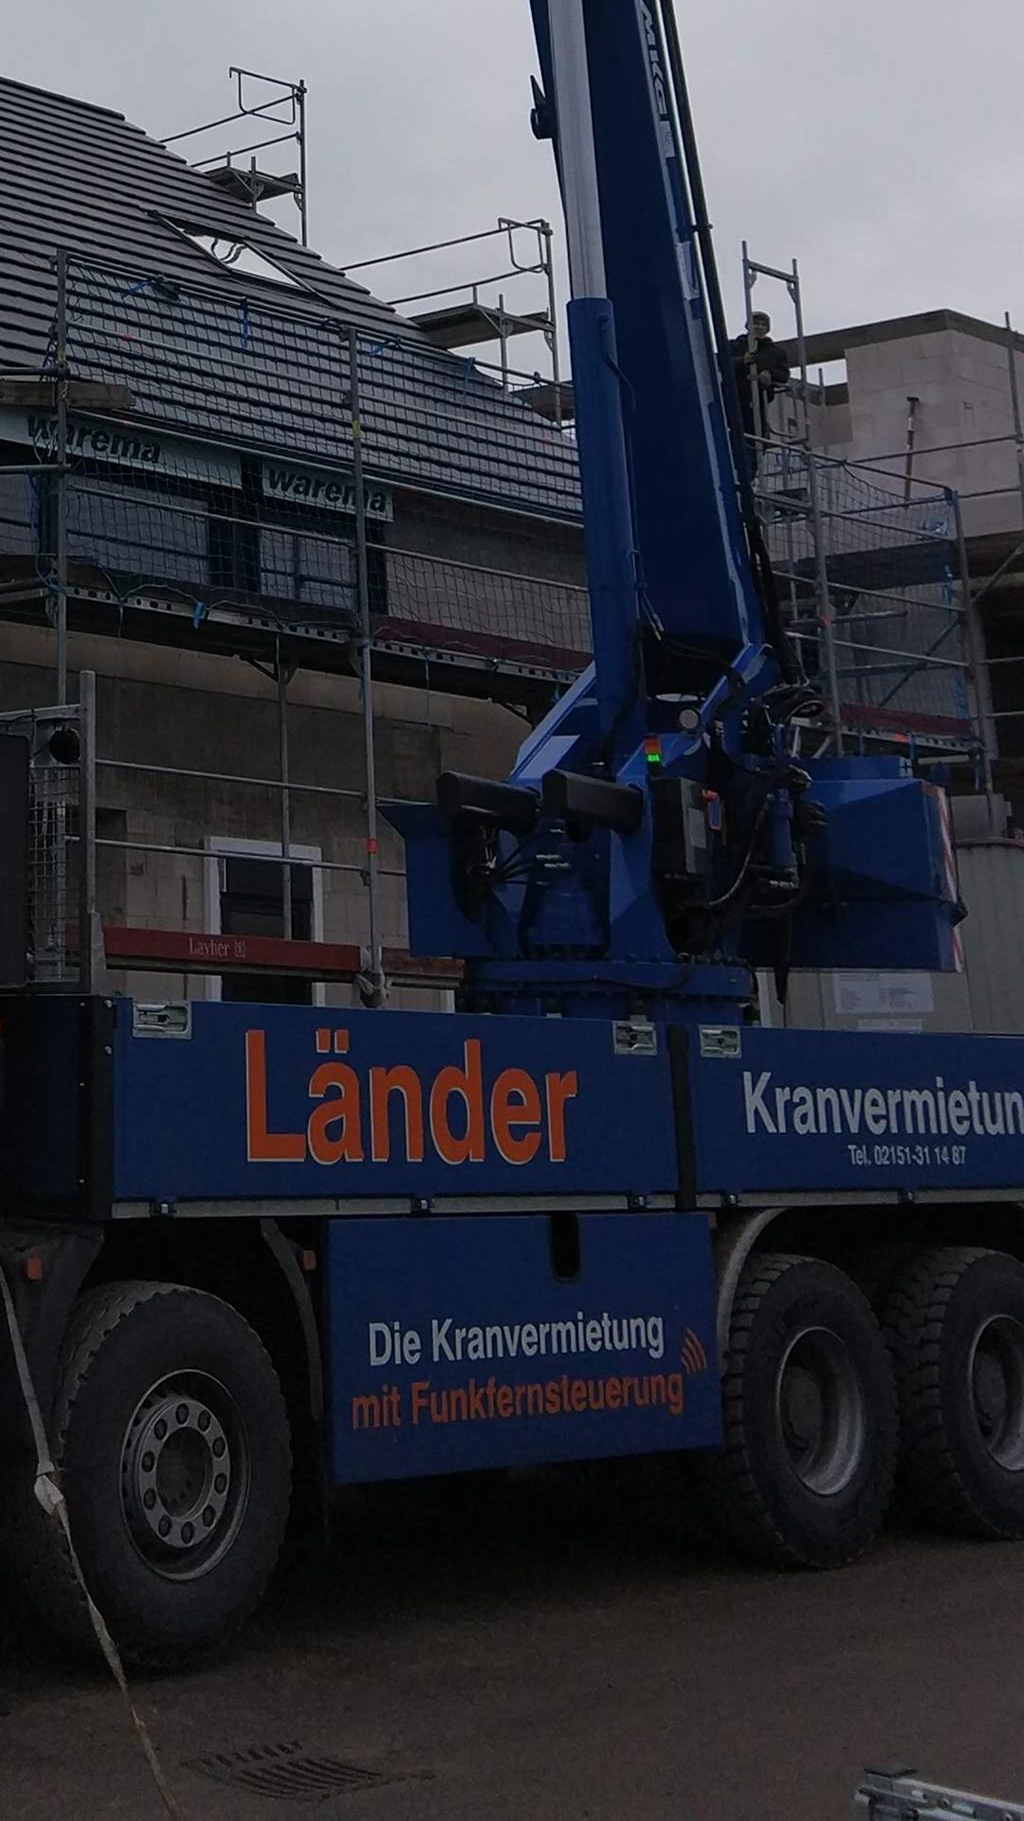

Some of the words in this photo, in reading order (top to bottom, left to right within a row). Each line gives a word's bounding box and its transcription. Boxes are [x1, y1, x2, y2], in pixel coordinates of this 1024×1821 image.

[269, 468, 386, 513] warema
[244, 1028, 578, 1166] Länder
[743, 1071, 1024, 1136] Kranvermietun
[847, 1144, 872, 1166] Tel.
[368, 1321, 422, 1367] Die
[431, 1312, 664, 1363] Kranvermietung
[351, 1384, 401, 1430] mit
[410, 1373, 684, 1426] Funkfernsteuerung
